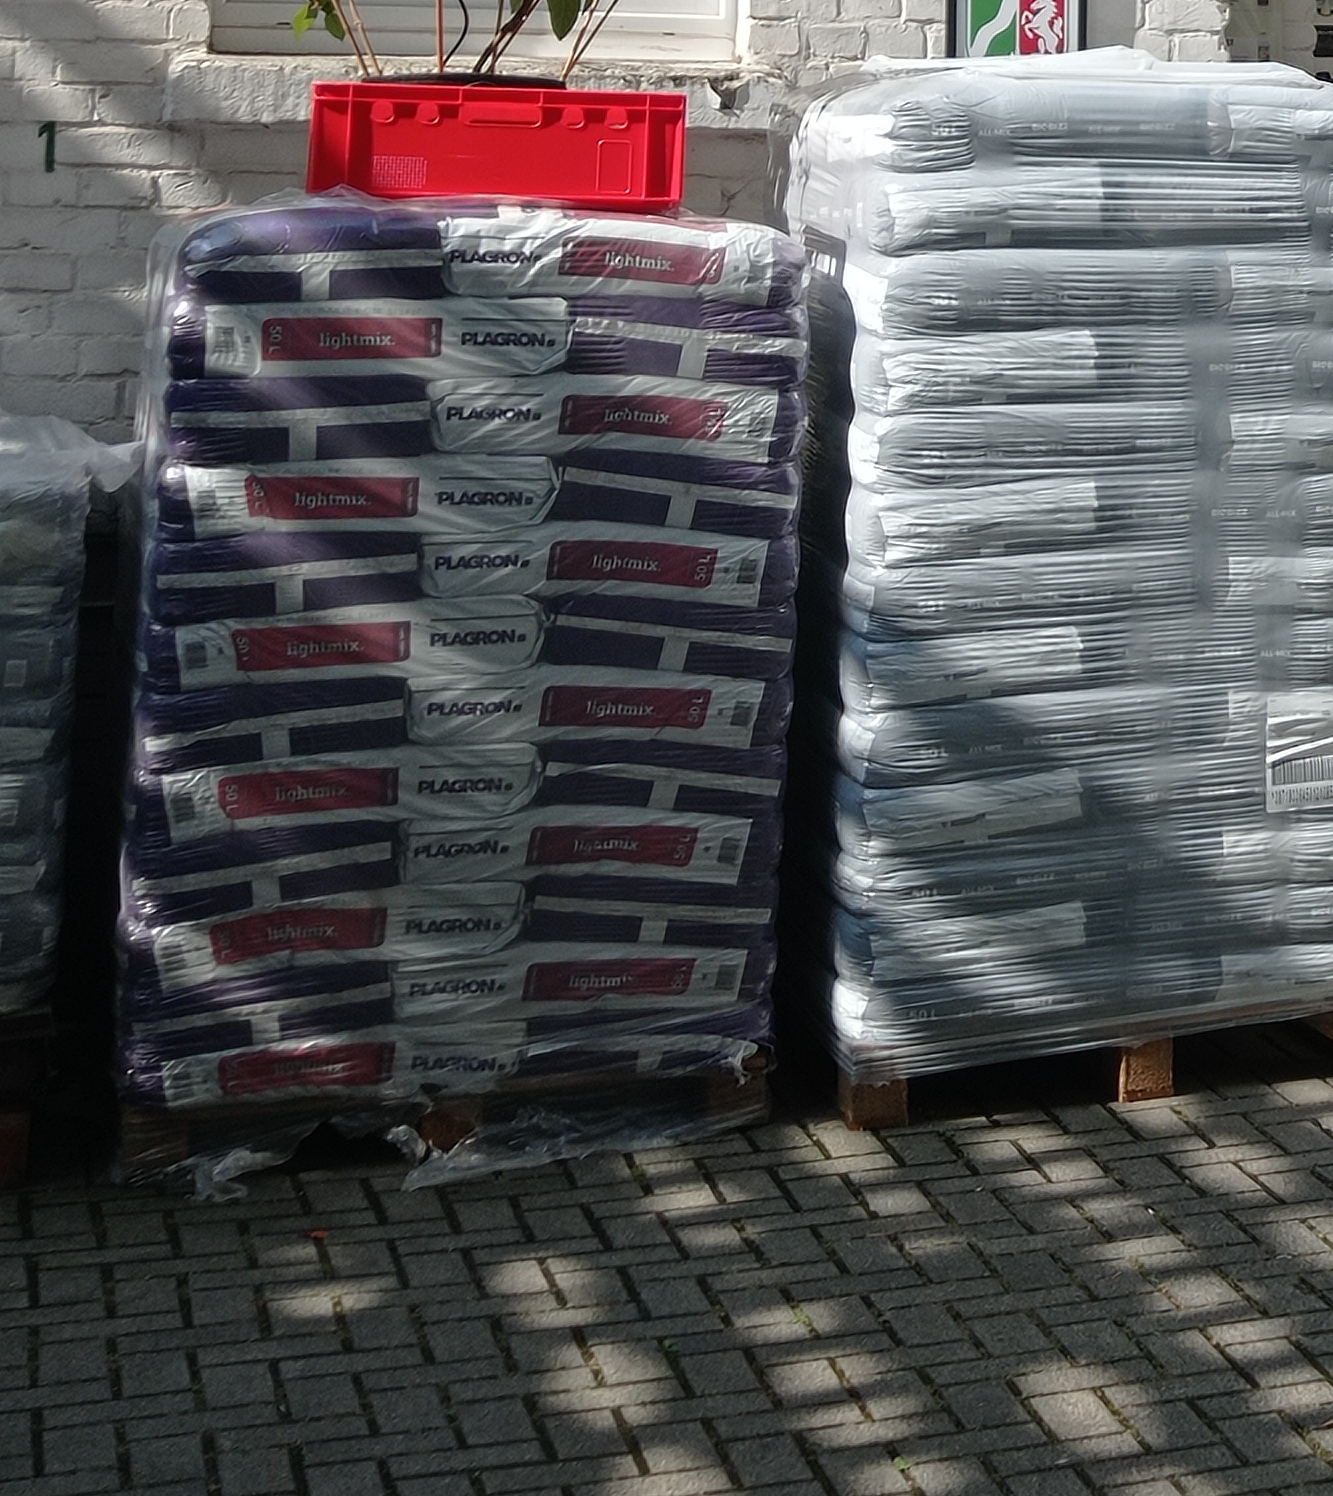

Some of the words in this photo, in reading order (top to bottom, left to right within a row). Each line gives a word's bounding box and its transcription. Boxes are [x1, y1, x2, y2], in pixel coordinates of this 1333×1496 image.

[450, 250, 534, 264] PLAGRON
[604, 251, 675, 271] lightmix.
[319, 332, 396, 349] lightmix.
[461, 332, 546, 348] PLAGRON
[446, 406, 532, 422] PLAGRON
[603, 408, 674, 425] lightmix.
[295, 492, 371, 509] lightmix.
[437, 491, 524, 506] PLAGRON
[434, 555, 519, 570] PLAGRON
[592, 555, 661, 572] lightmix.
[287, 637, 365, 659] lightmix.
[430, 630, 516, 647] PLAGRON
[427, 700, 513, 716] PLAGRON
[417, 779, 502, 794] PLAGRON
[413, 840, 499, 858] PLAGRON
[405, 918, 491, 934] PLAGRON
[410, 979, 496, 996] PLAGRON
[411, 1056, 498, 1071] PLAGRON
